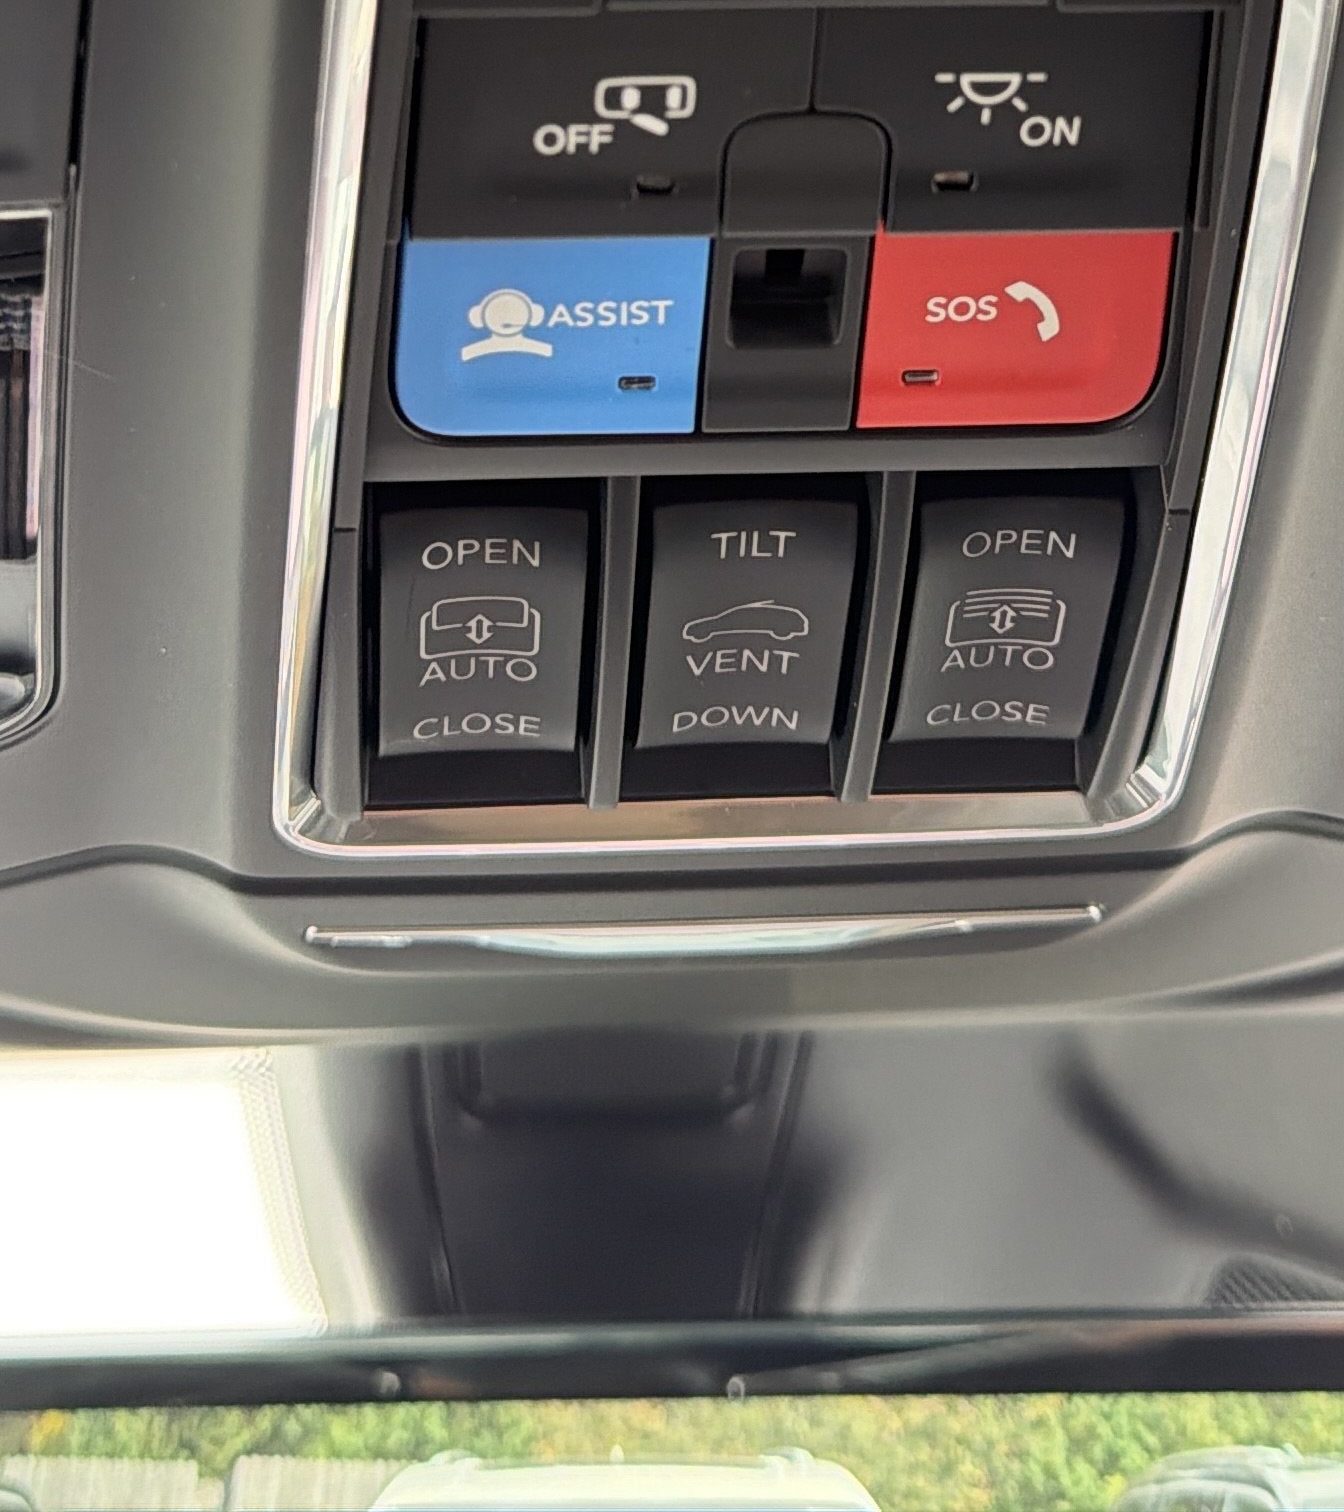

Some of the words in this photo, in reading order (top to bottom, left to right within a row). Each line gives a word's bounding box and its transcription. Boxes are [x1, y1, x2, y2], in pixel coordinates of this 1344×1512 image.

[533, 124, 613, 155] OFF
[1019, 116, 1081, 147] ON
[547, 300, 674, 328] ASSIST
[924, 295, 999, 323] SOS
[421, 538, 540, 570] OPEN
[712, 530, 796, 559] TILT
[962, 529, 1076, 559] OPEN
[419, 657, 538, 686] AUTO
[685, 649, 799, 675] VENT
[940, 645, 1054, 672] AUTO
[413, 713, 541, 740] CLOSE
[672, 705, 799, 732] DOWN
[926, 700, 1050, 726] CLOSE
